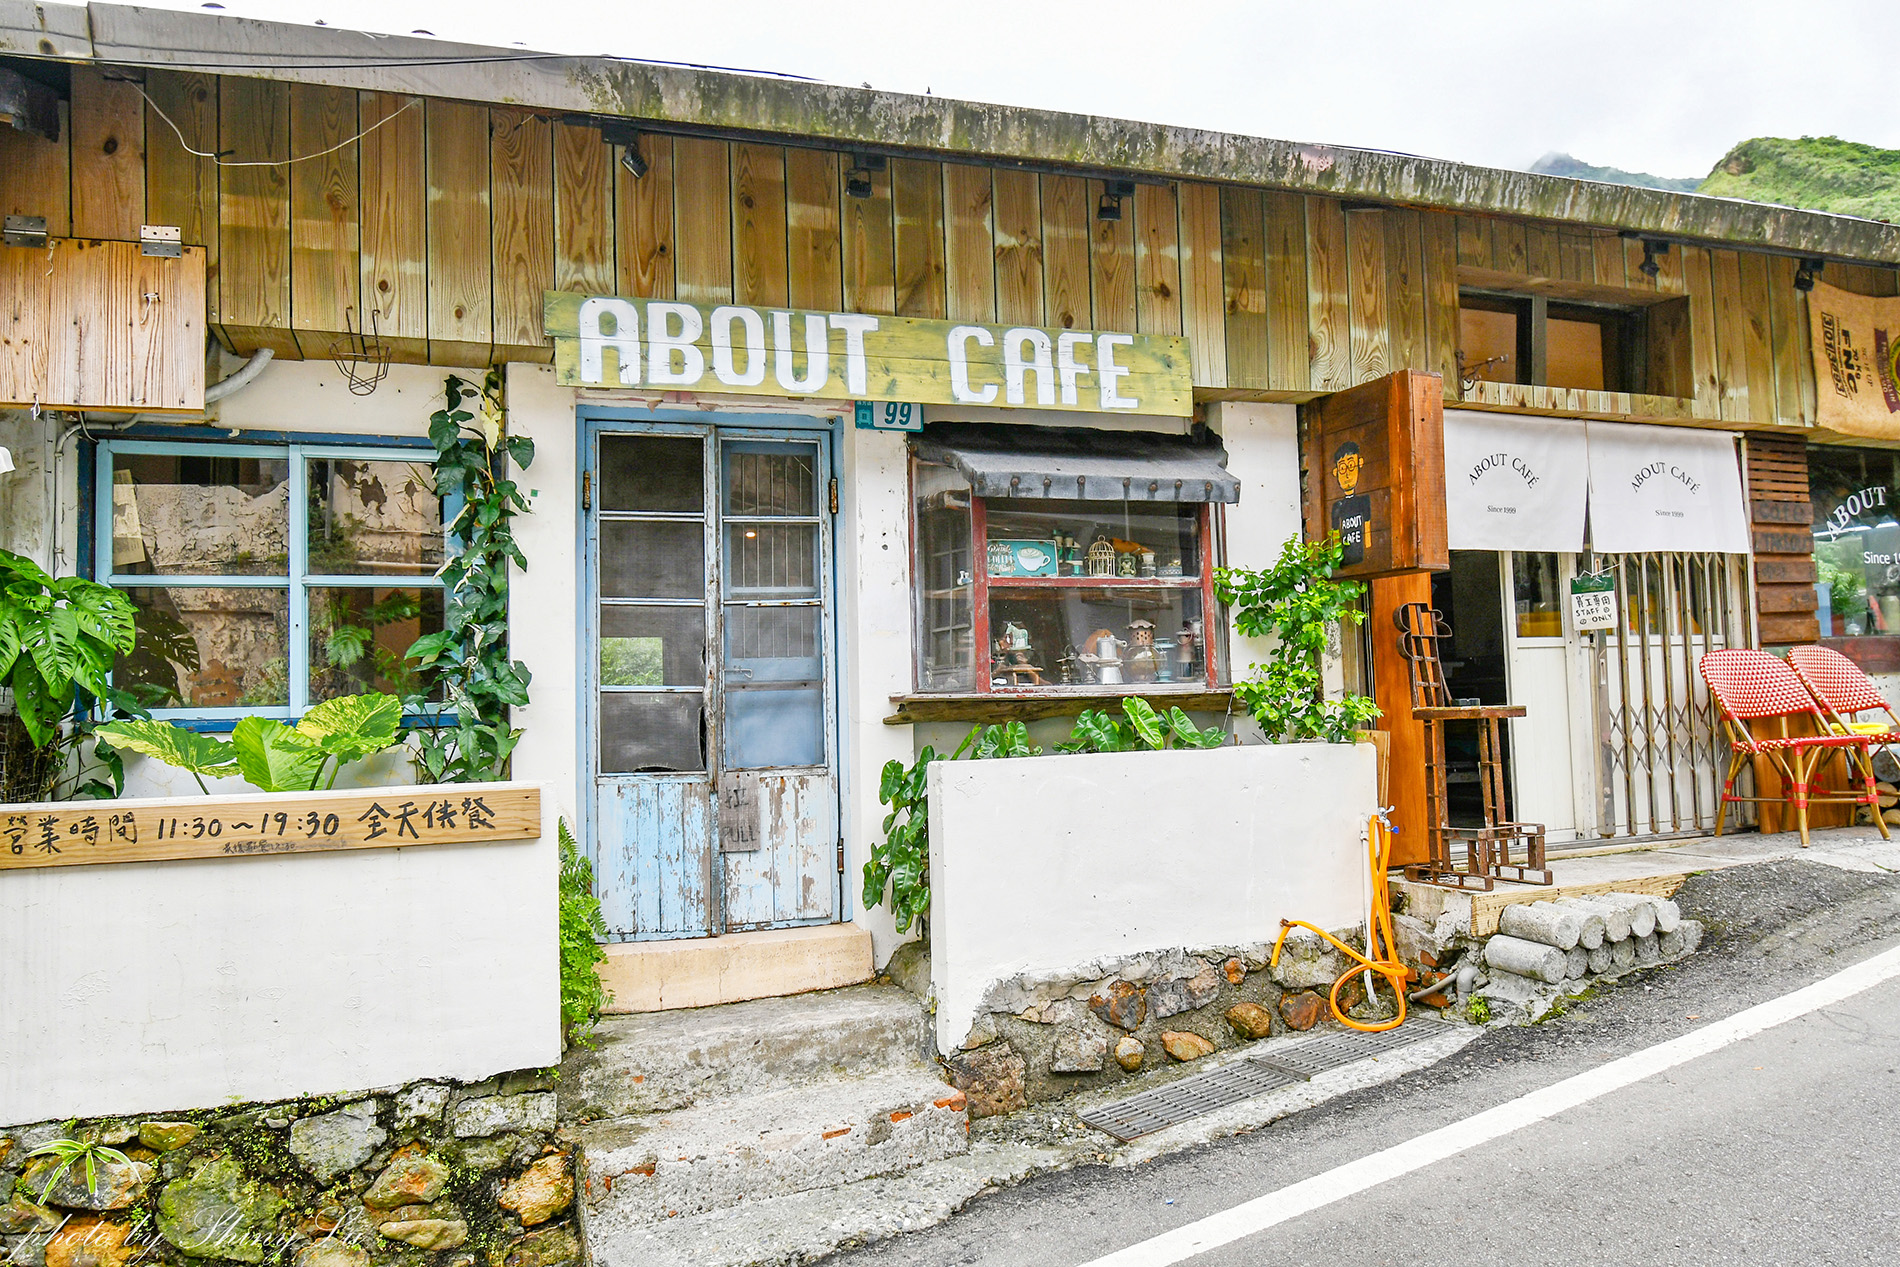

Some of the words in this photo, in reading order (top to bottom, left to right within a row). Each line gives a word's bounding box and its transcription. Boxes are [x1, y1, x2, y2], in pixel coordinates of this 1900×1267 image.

[579, 297, 879, 396] ABOUT
[947, 325, 1139, 408] CAFE
[1841, 328, 1858, 394] FNC
[884, 402, 912, 426] 99
[1468, 453, 1508, 486] ABOUT
[1512, 457, 1540, 489] CAFÉ
[1631, 461, 1666, 493] ABOUT
[1670, 465, 1701, 495] CAFÉ
[1487, 505, 1503, 514] Since
[1503, 506, 1517, 515] 1999
[1655, 509, 1671, 518] Since
[1826, 486, 1886, 543] ABOUT
[1342, 515, 1362, 530] ABOUT
[1342, 531, 1361, 545] CAFE
[1863, 551, 1891, 565] Since
[1575, 608, 1600, 617] STAFF
[1592, 613, 1612, 622] ONLY
[3, 811, 138, 854] 營業時間
